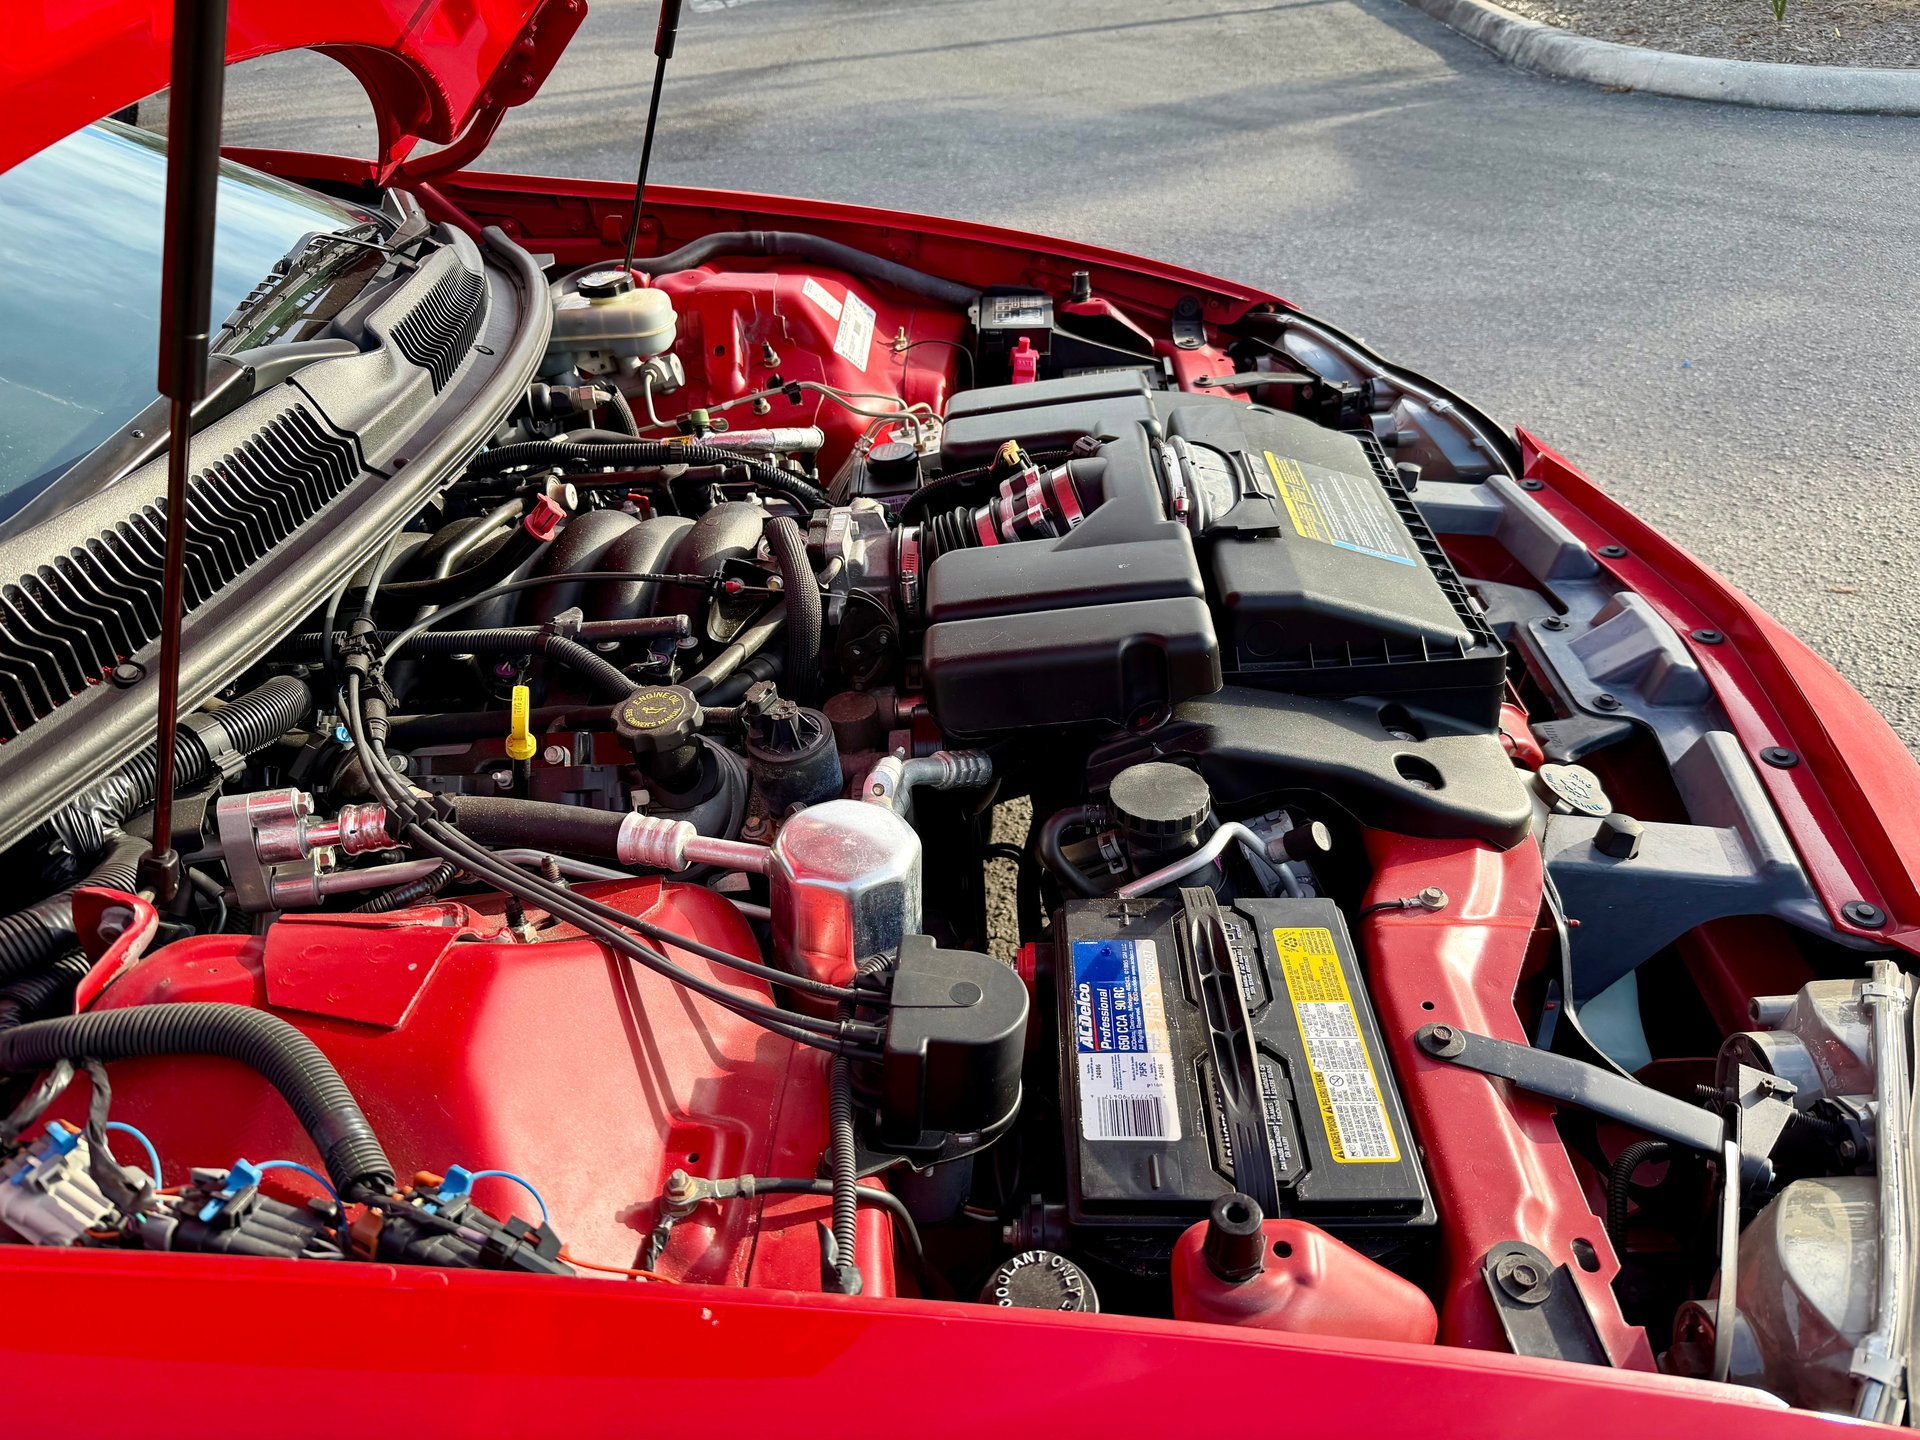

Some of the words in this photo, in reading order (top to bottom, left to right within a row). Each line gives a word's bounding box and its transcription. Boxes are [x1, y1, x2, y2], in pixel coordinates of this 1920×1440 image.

[632, 692, 670, 706] ENGINE
[668, 694, 681, 705] OIL
[625, 708, 634, 719] SEE
[658, 707, 682, 726] MANUAL
[1113, 987, 1125, 998] RC
[1114, 1000, 1127, 1010] 90
[1077, 982, 1094, 1049] ACDelco
[1097, 988, 1113, 1050] Professional
[1115, 1014, 1129, 1033] CCA
[1118, 1035, 1131, 1051] 650
[1138, 1062, 1148, 1078] 75PS
[1266, 1064, 1274, 1079] BURNS
[1262, 1071, 1271, 1095] BLINDNESS
[1270, 1079, 1278, 1095] SEVERE
[1268, 1102, 1276, 1120] FLAMES
[1274, 1099, 1283, 1120] SMOKING
[1272, 1125, 1283, 1147] BLINDNESS
[1281, 1136, 1290, 1151] INJURY
[1277, 1148, 1286, 1161] CAUSE
[1279, 1161, 1287, 1170] CAN
[995, 1250, 1047, 1308] COOLANT
[1051, 1255, 1082, 1297] ONLY
